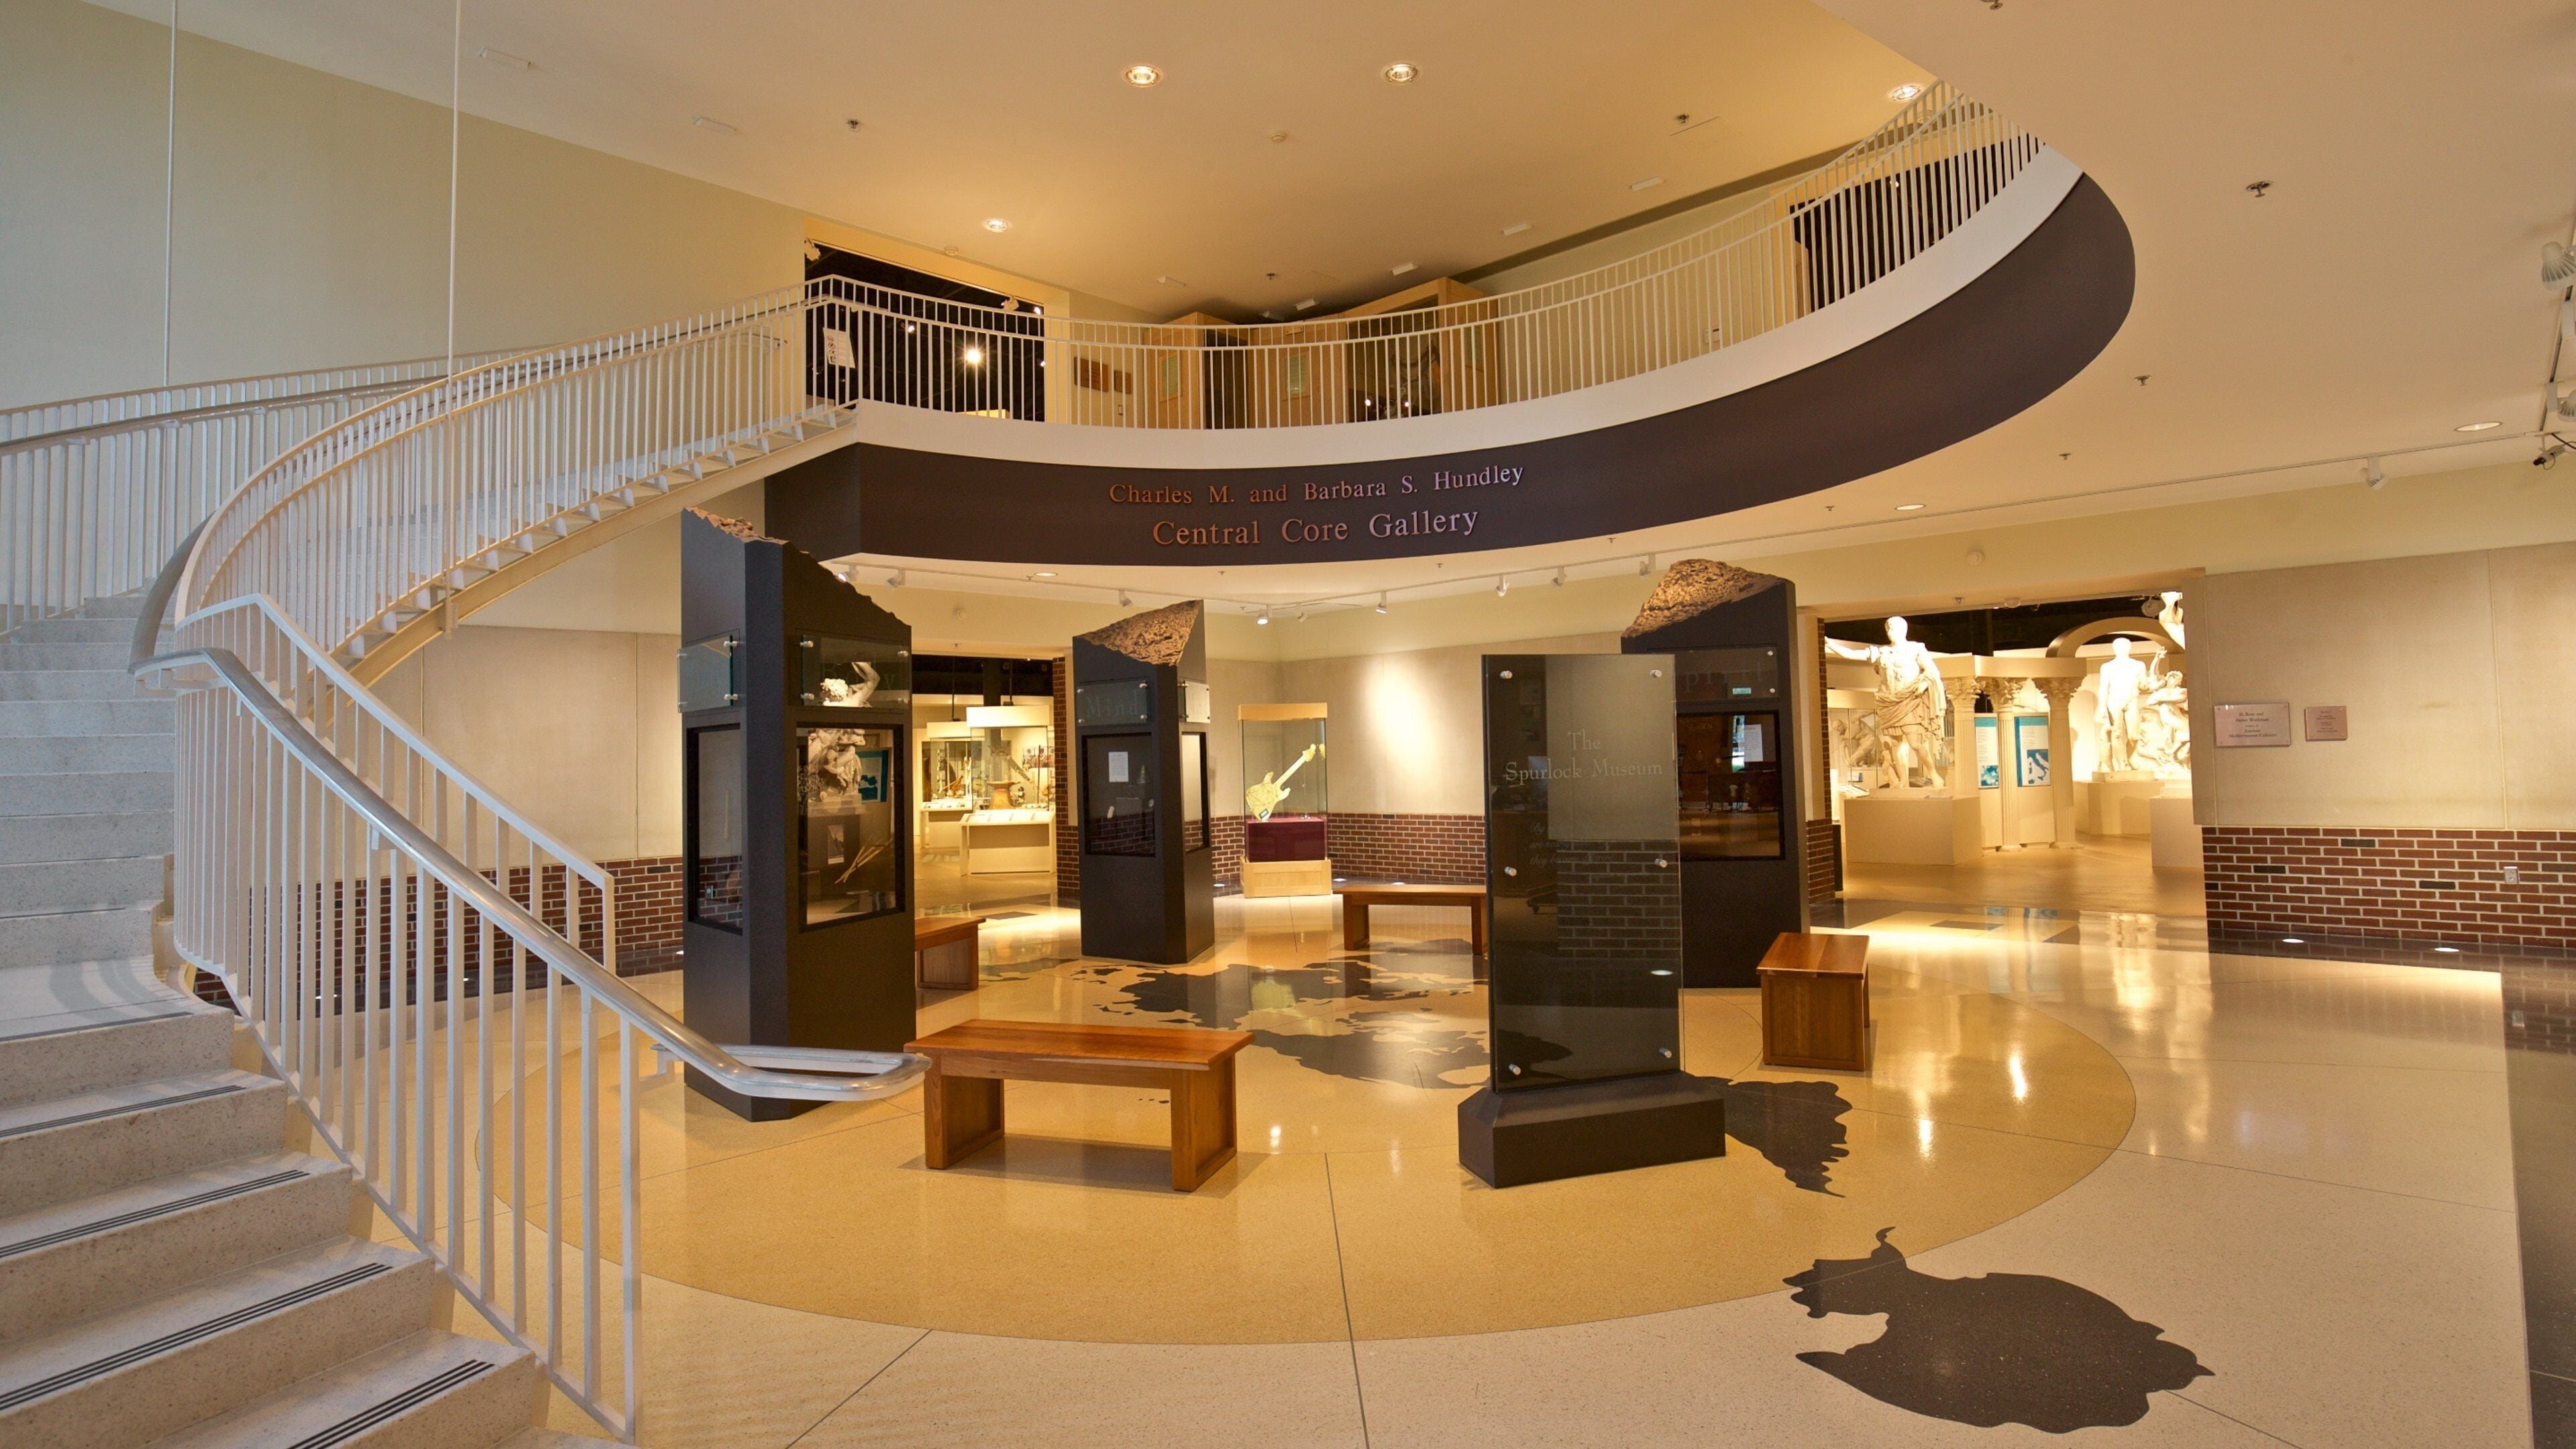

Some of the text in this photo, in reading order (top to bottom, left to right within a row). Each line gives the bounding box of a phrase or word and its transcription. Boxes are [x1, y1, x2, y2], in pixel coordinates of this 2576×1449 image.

[1109, 466, 1524, 504] Charles M. and Barbara S. Hundley
[1152, 510, 1479, 545] Central Core Gallery
[1684, 661, 1764, 694] pirit
[1086, 688, 1140, 718] Mind
[1567, 729, 1601, 751] The
[1505, 757, 1662, 786] Spurlock Museum
